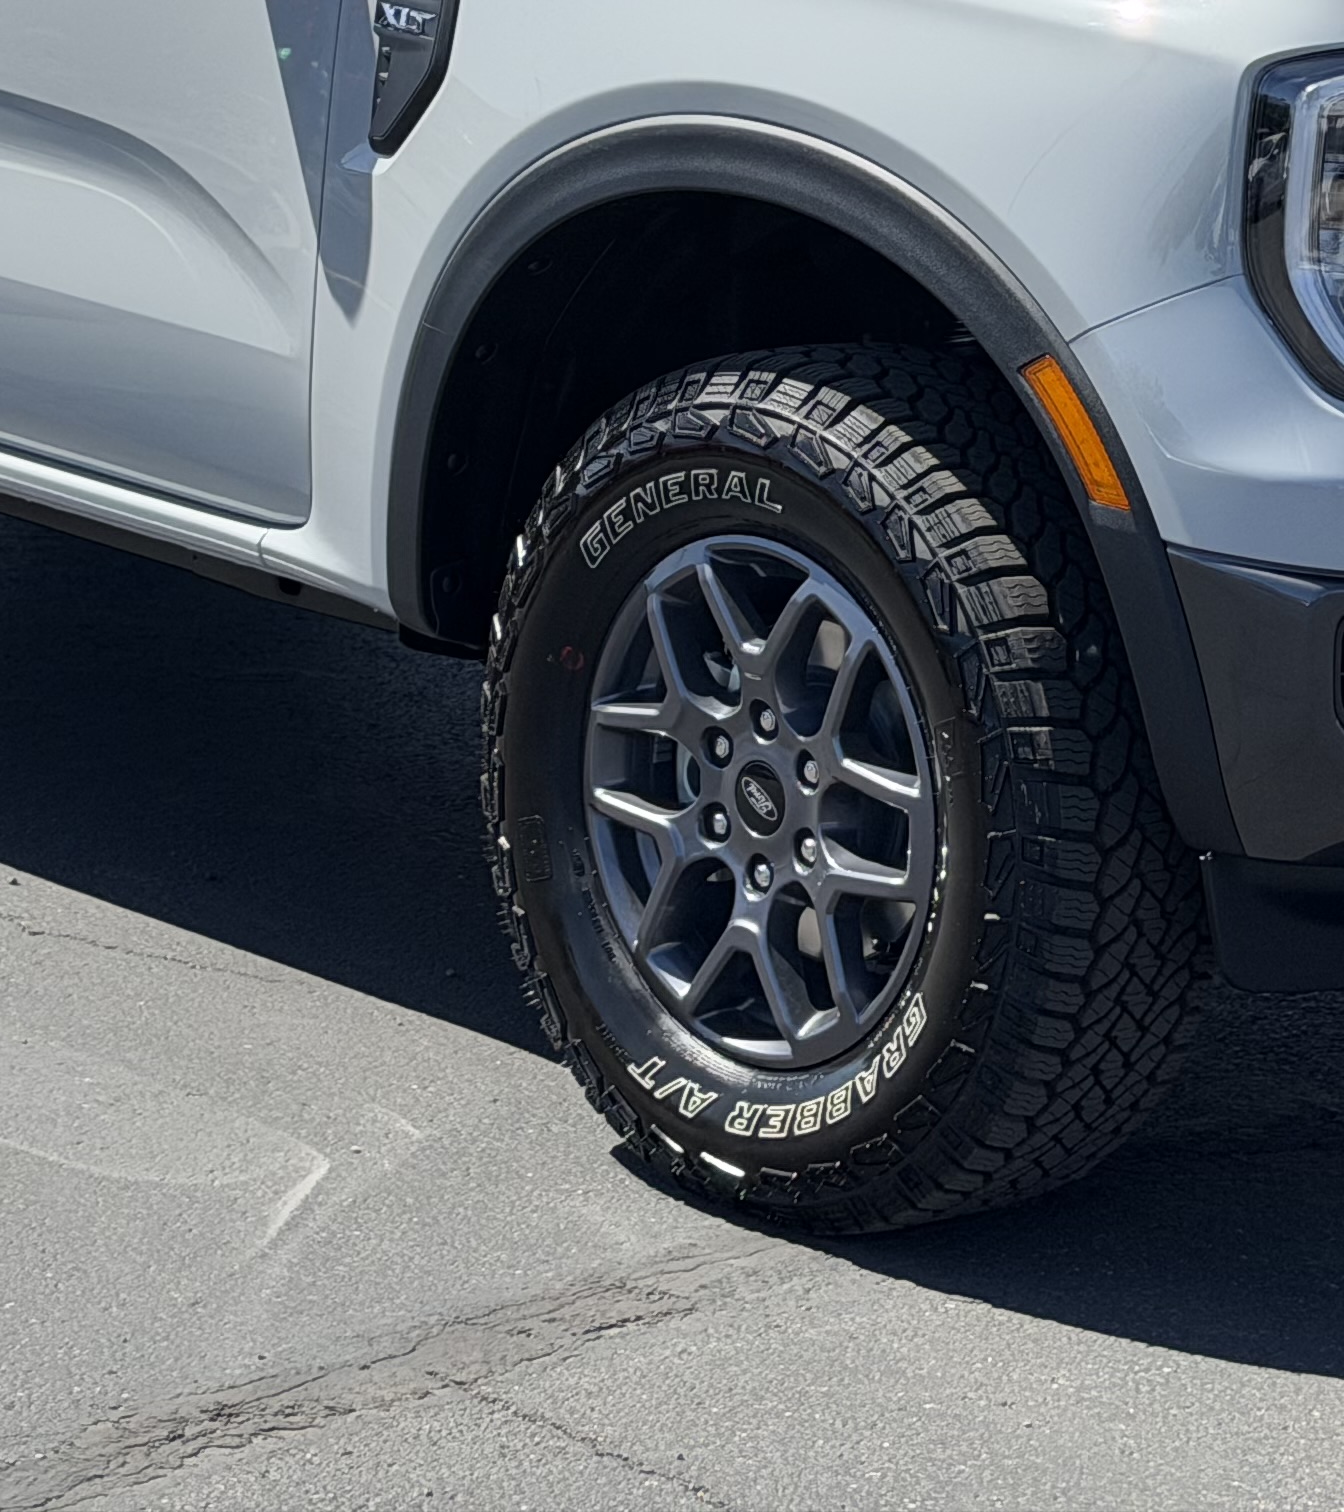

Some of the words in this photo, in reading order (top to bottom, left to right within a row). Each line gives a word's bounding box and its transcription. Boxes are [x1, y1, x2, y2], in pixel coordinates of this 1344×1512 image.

[379, 1, 437, 35] XLT
[579, 467, 784, 569] GENERAL
[627, 1055, 719, 1119] A/T
[724, 992, 928, 1139] GRABBER
